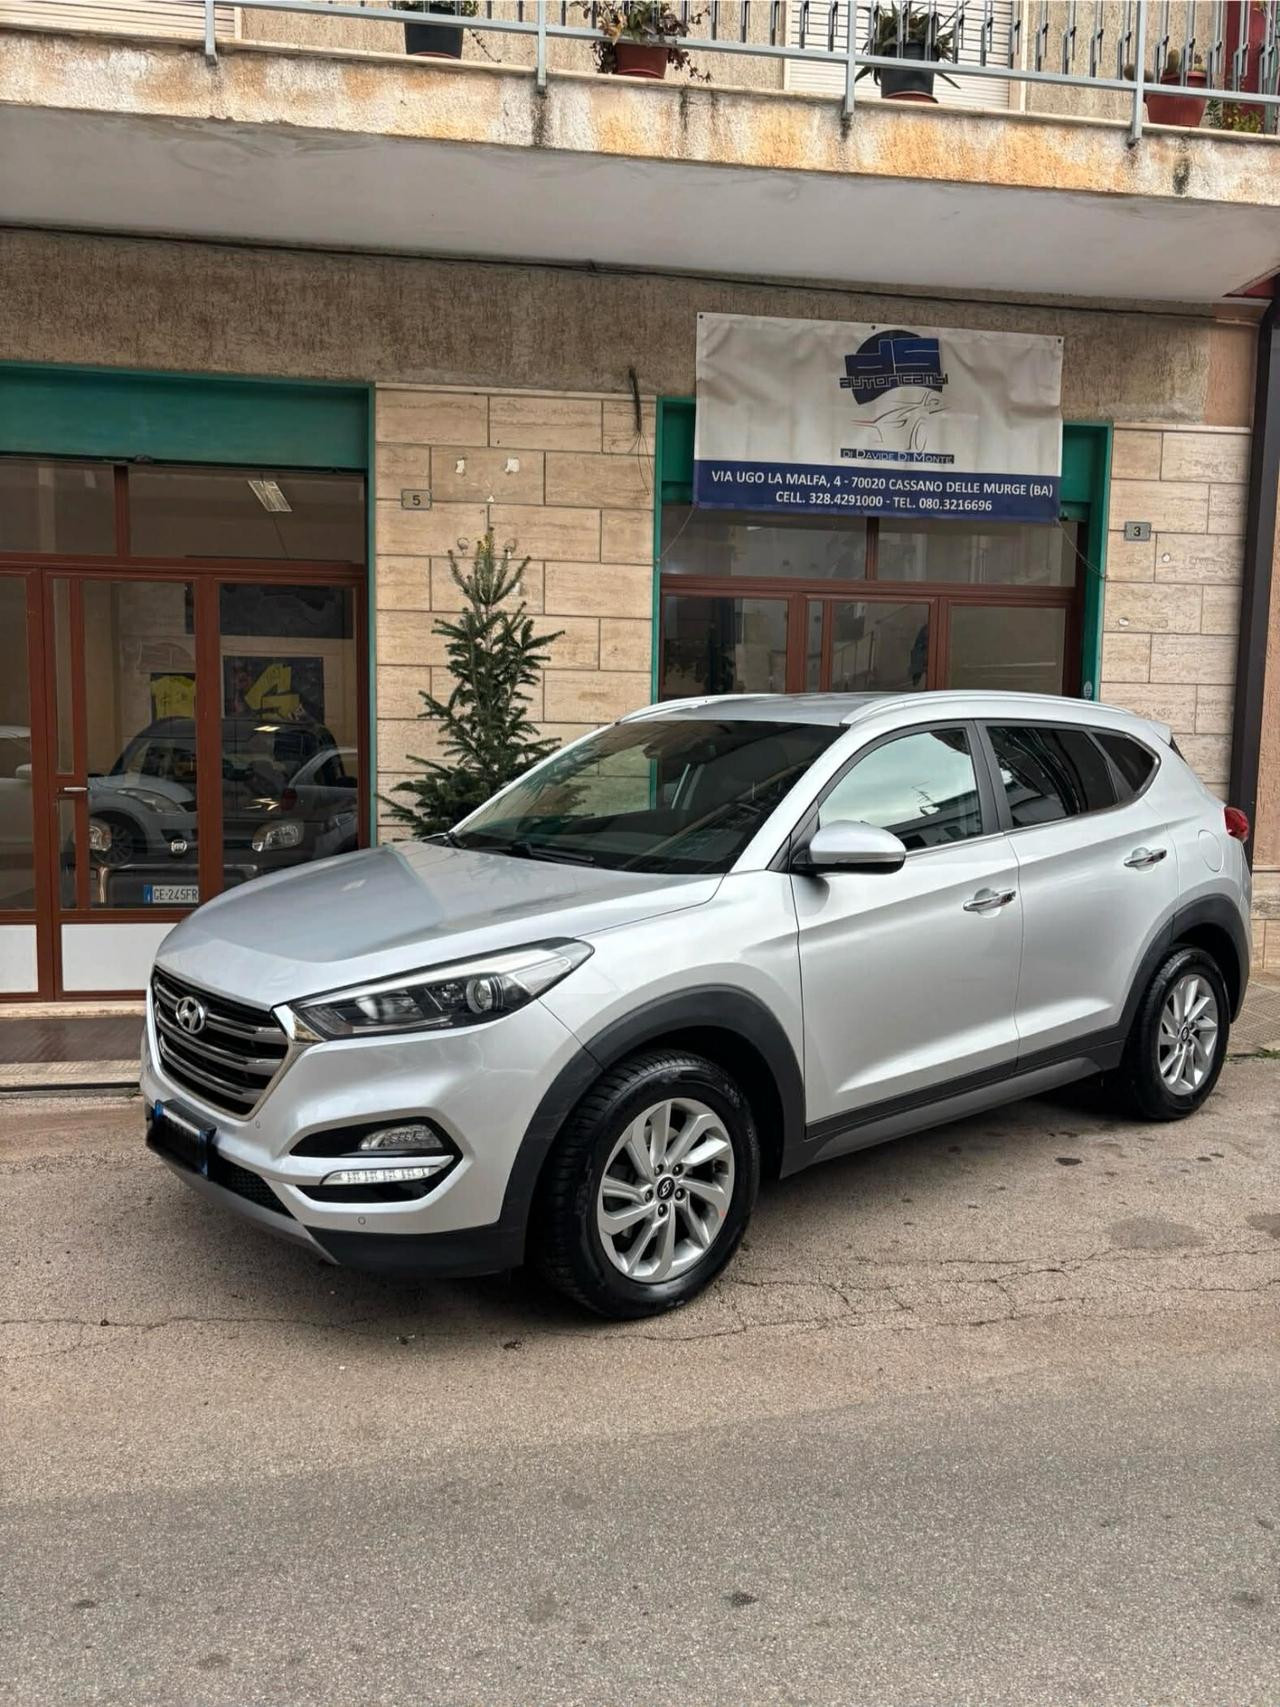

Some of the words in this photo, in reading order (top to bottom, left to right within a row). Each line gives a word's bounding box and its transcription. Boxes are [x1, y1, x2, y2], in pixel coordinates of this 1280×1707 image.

[711, 470, 733, 483] VIA
[736, 471, 765, 484] UGO
[768, 472, 783, 484] LA
[786, 473, 831, 488] MALFA,
[833, 475, 841, 487] 4
[851, 476, 886, 490] 70020
[888, 479, 943, 492] CASSANO
[946, 481, 980, 494] DELLE
[983, 482, 1027, 496] MURGE
[1029, 483, 1053, 498] (BA)
[412, 494, 421, 506] 5
[775, 491, 806, 504] CELL.
[809, 492, 883, 507] 328.4291000
[893, 496, 916, 509] TEL.
[919, 497, 993, 512] 080.3216696
[1133, 526, 1141, 537] 3
